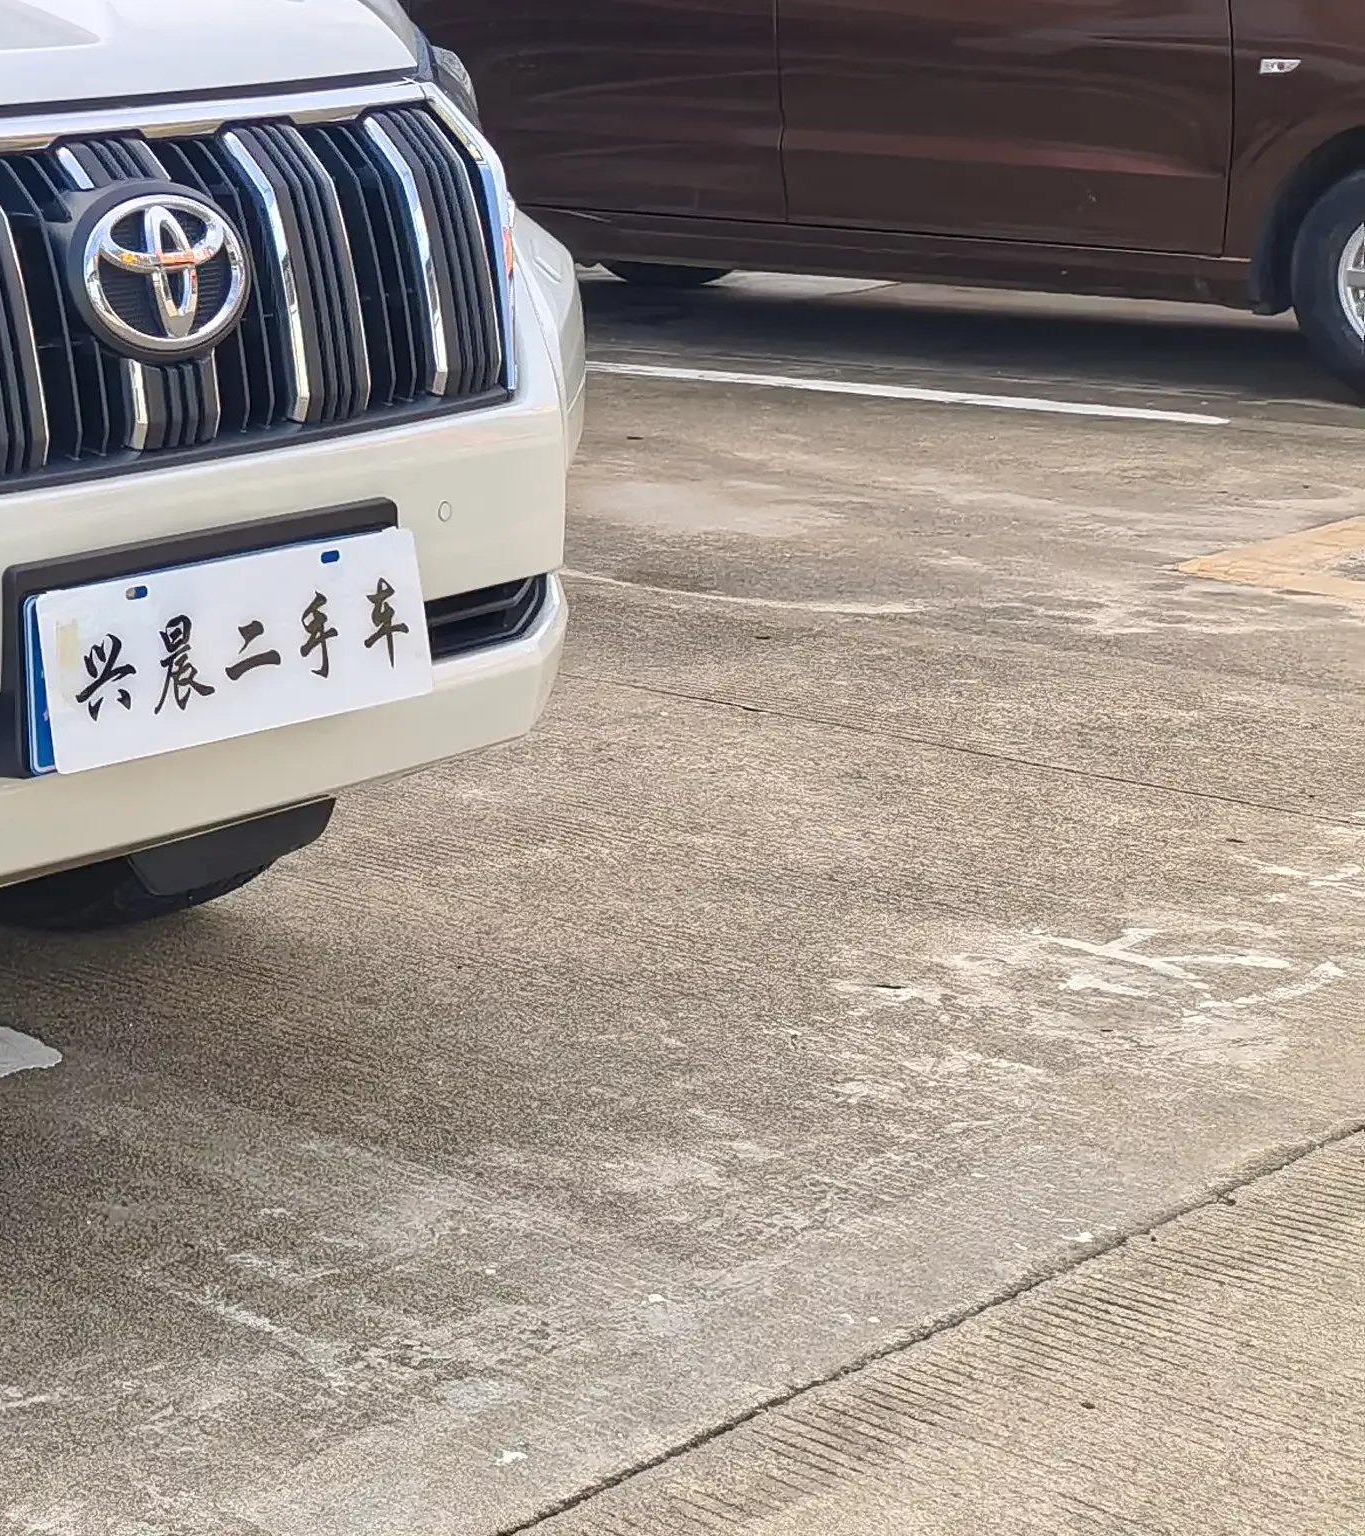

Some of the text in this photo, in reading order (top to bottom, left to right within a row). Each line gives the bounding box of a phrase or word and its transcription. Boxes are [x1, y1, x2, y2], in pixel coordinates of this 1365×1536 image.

[76, 578, 409, 722] 兴晨二手车
